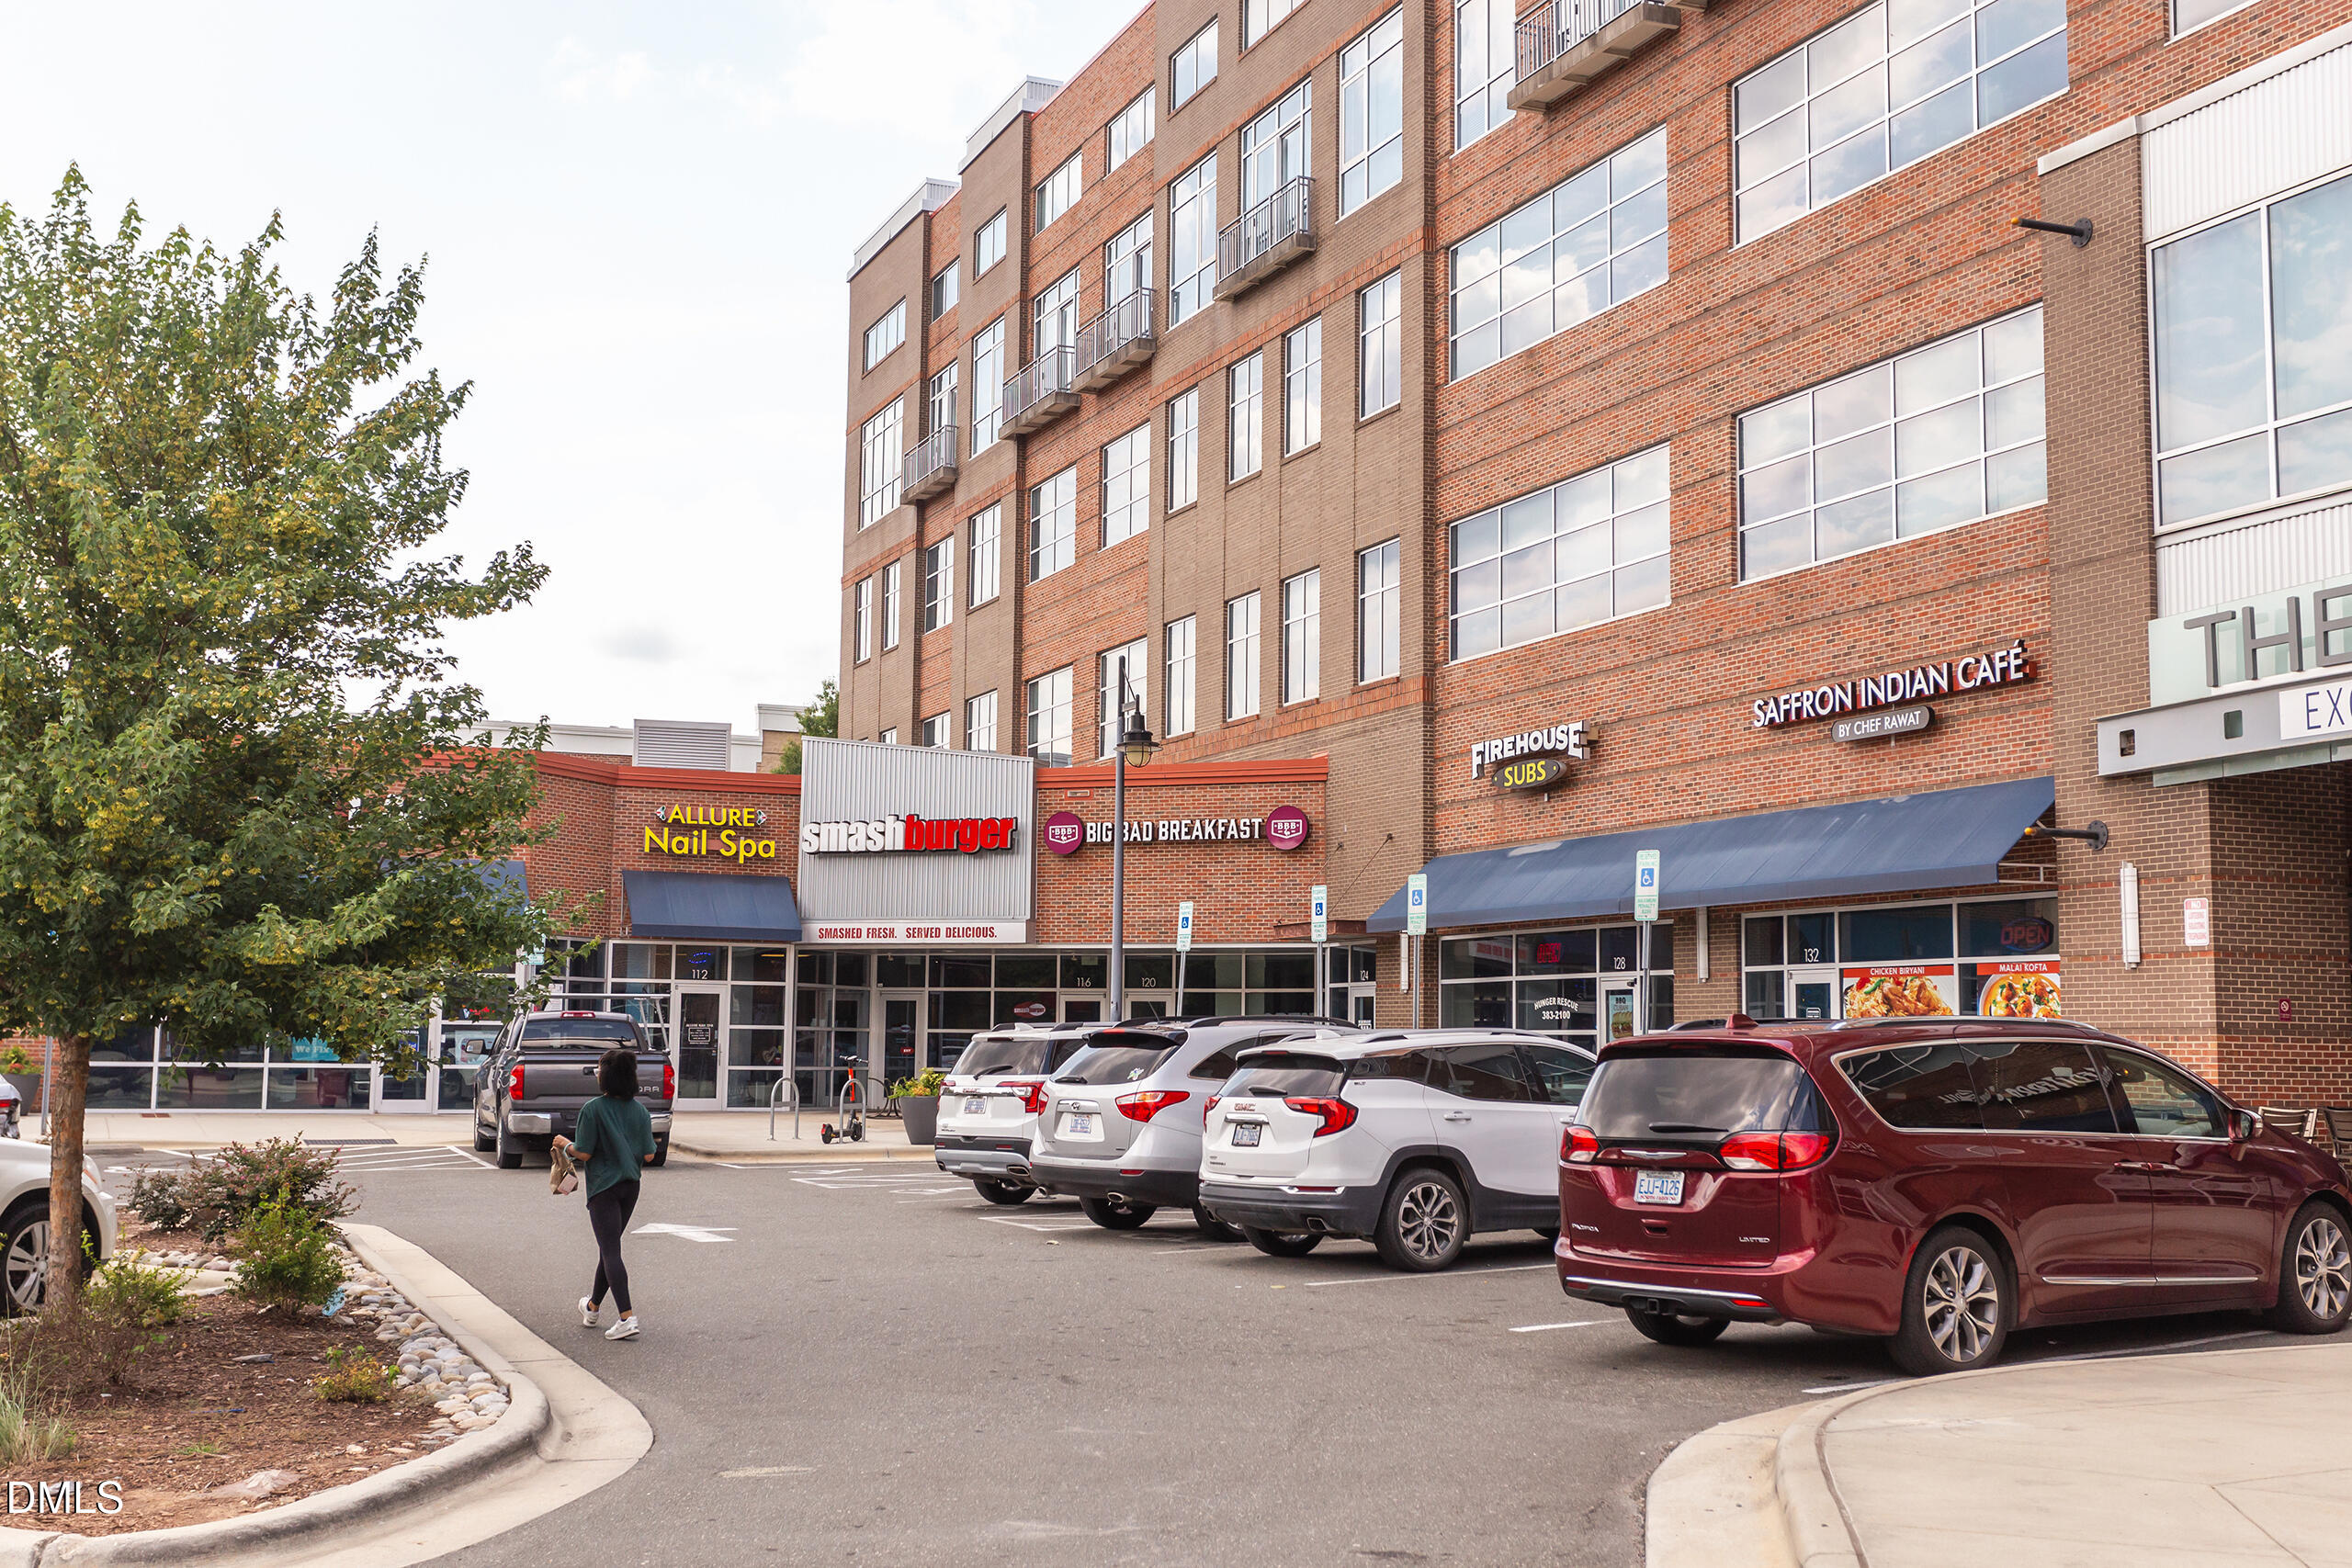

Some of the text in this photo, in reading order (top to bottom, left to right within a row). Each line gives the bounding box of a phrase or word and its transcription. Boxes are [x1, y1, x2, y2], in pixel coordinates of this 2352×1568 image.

[2184, 584, 2352, 687] THE
[1753, 638, 2025, 728] SAFFRON INDIAN CAFÉ
[2306, 686, 2352, 730] EX
[1838, 710, 1921, 738] BY CHEF RAWAT
[1471, 720, 1585, 779] FIREHOUSE
[1504, 761, 1546, 787] SUBS
[668, 804, 756, 827] ALLURE
[802, 813, 1017, 854] smashburger
[1086, 822, 1114, 842] BIG
[1159, 818, 1262, 840] BREAKFAST
[644, 826, 775, 863] Nail Spa
[818, 926, 998, 939] SMASHED FRESH. SERVED DELICIOUS.
[2001, 925, 2052, 945] OPEN
[1537, 942, 1561, 963] OPEN
[1804, 948, 1819, 963] 132
[1614, 957, 1625, 969] 128
[1871, 966, 1925, 976] CHICKEN BIRYANI
[1999, 963, 2048, 973] MALAI KOFTA
[692, 969, 708, 979] 112
[1077, 977, 1091, 987] 116
[1142, 977, 1156, 987] 120
[1360, 970, 1369, 981] 124
[1534, 997, 1578, 1011] HUNGER RESCUE
[1542, 1010, 1570, 1020] 383-2100
[1639, 1179, 1680, 1196] EJJ-4126
